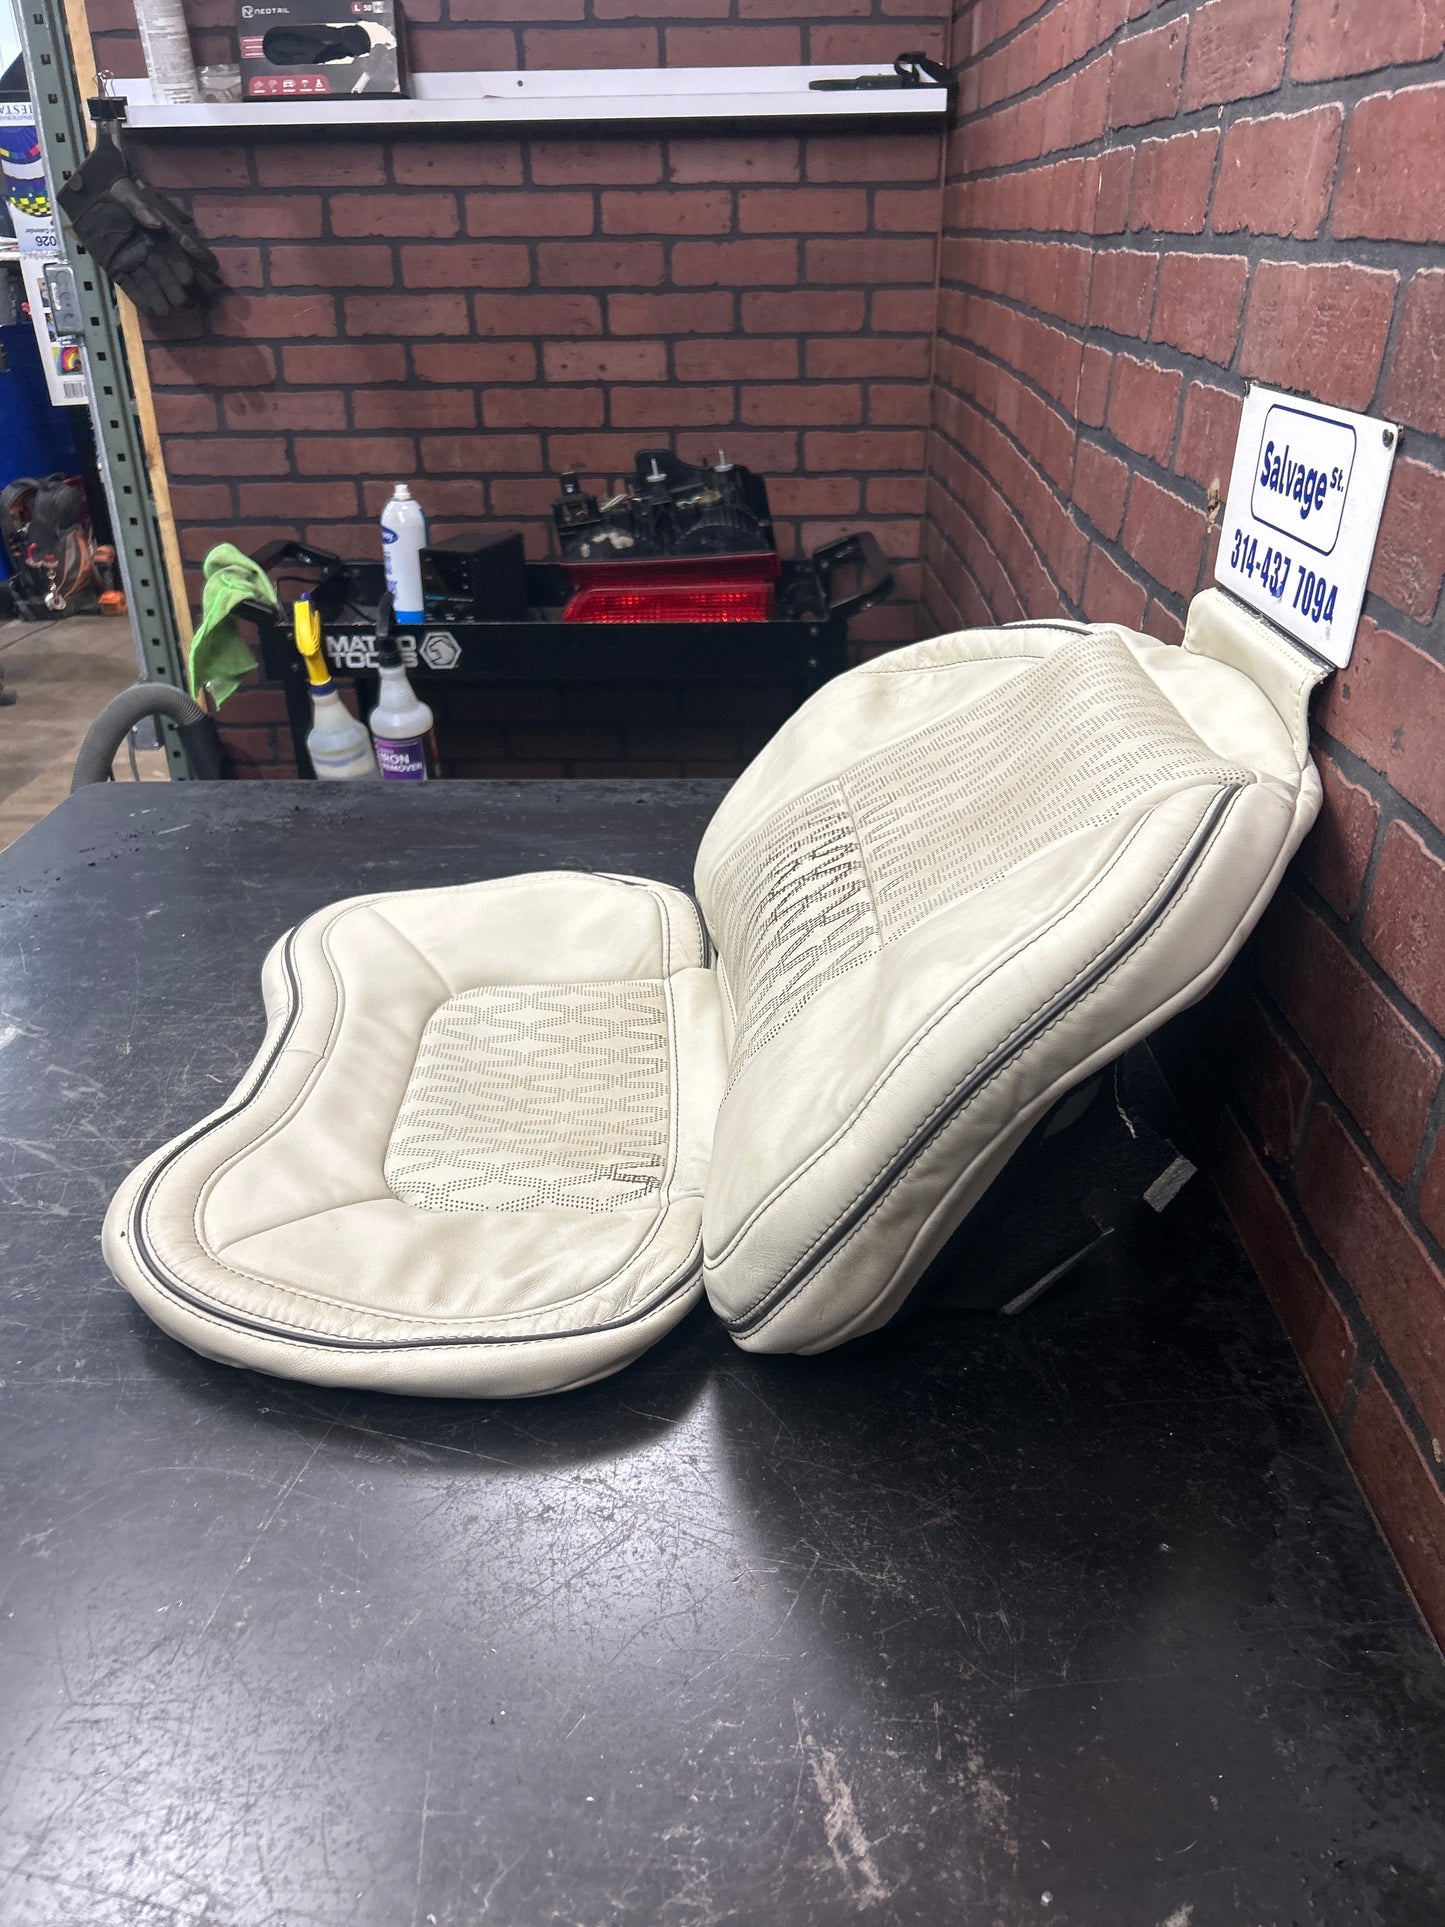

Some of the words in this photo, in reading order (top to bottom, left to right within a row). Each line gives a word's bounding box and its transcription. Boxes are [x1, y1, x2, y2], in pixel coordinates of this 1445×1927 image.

[363, 4, 372, 12] 50
[35, 235, 57, 247] 026
[1260, 440, 1328, 520] Salvage
[1231, 528, 1292, 599] 314-437
[1292, 564, 1338, 624] 7094
[326, 635, 417, 653] MATO
[328, 651, 419, 669] TOOS
